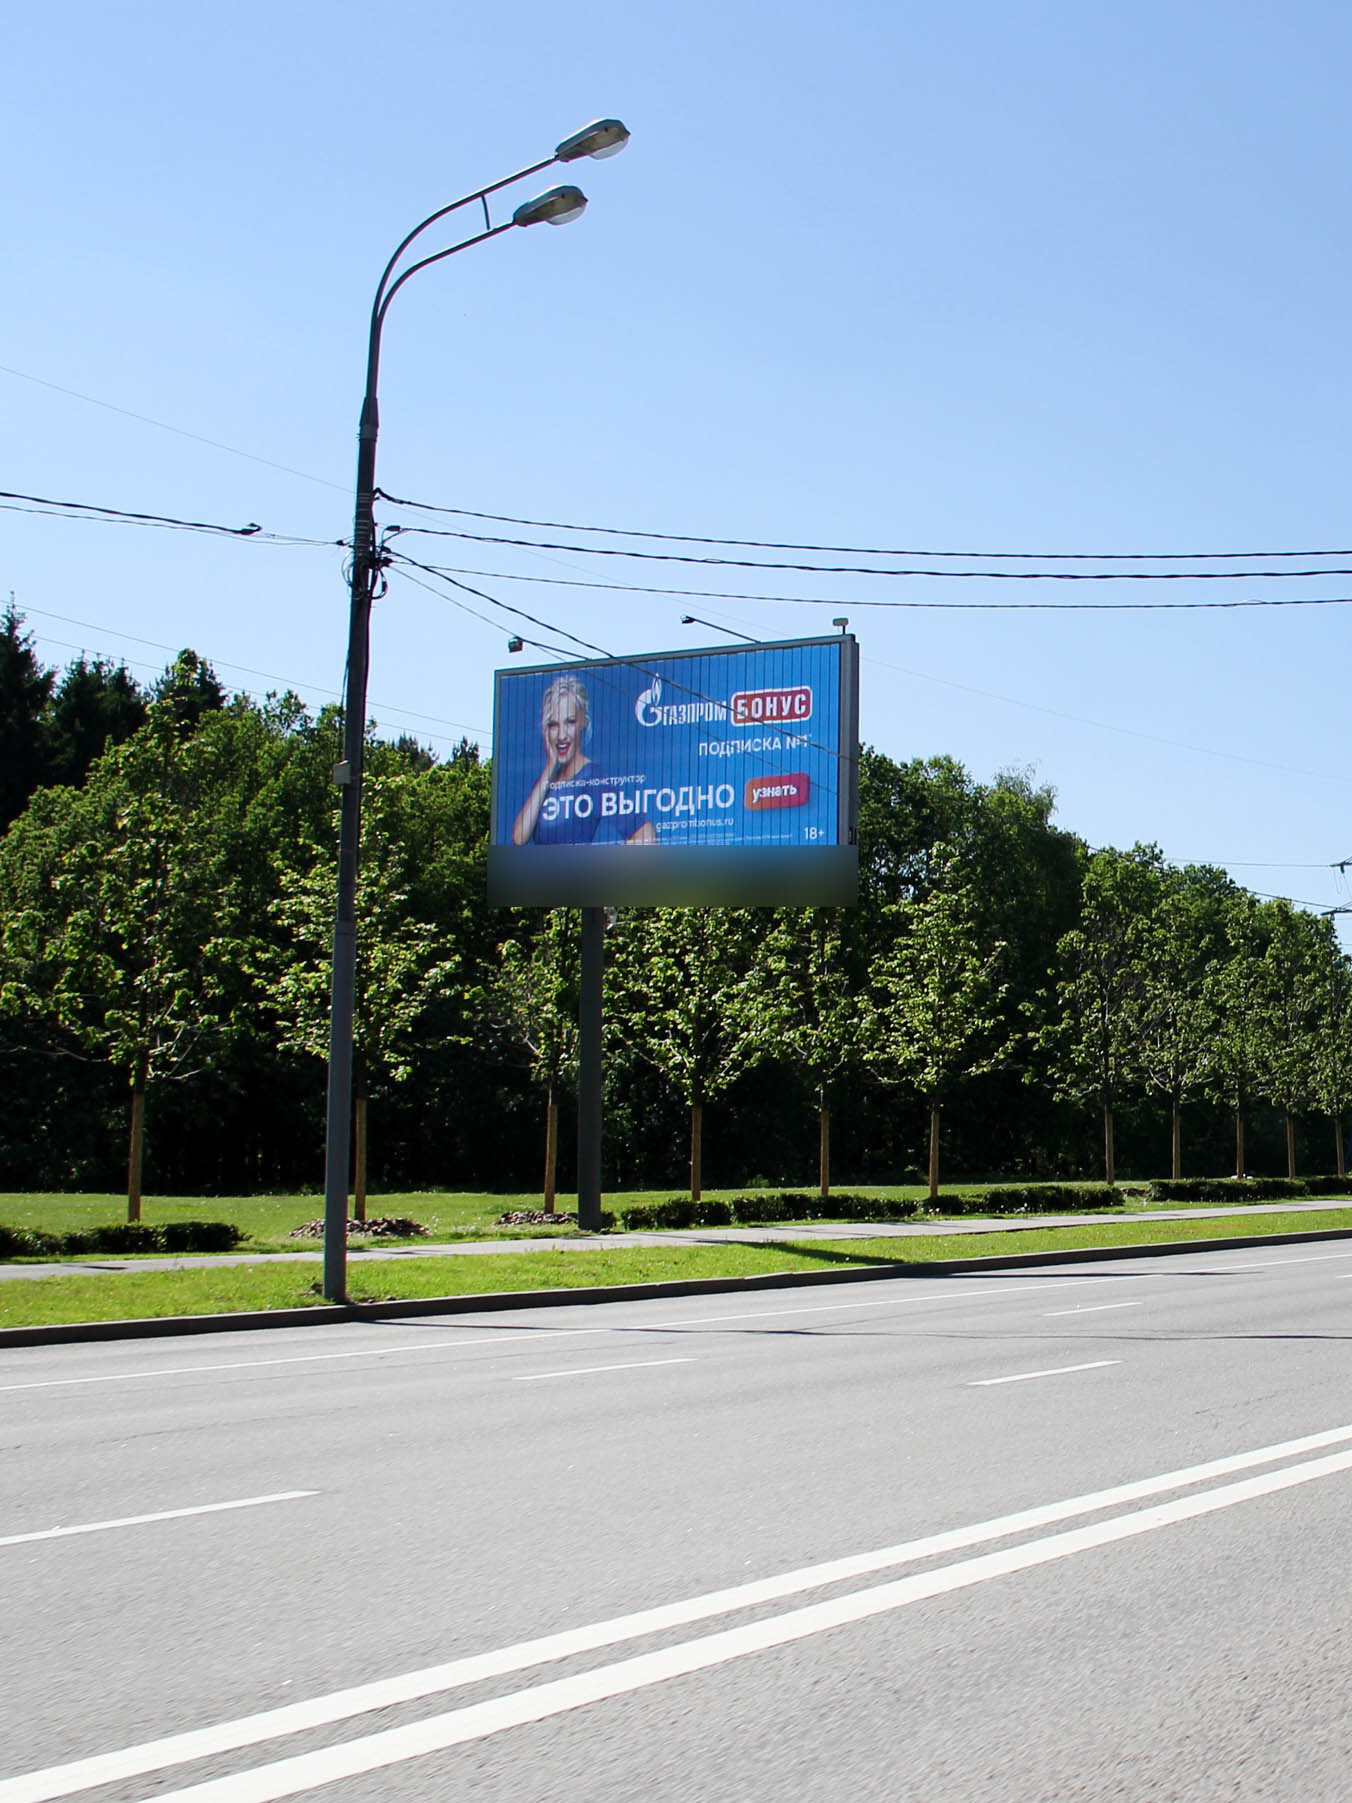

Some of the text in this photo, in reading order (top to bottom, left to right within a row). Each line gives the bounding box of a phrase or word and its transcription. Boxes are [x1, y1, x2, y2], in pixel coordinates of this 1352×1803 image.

[662, 693, 807, 726] ГАЗПРОМ БОНУС
[698, 737, 782, 757] ПОДПИСКА
[541, 783, 735, 821] ЭТО ВЫГОДНО
[752, 784, 798, 803] узнать
[655, 817, 734, 833] gazprombonus.ru
[803, 826, 825, 840] 18+
